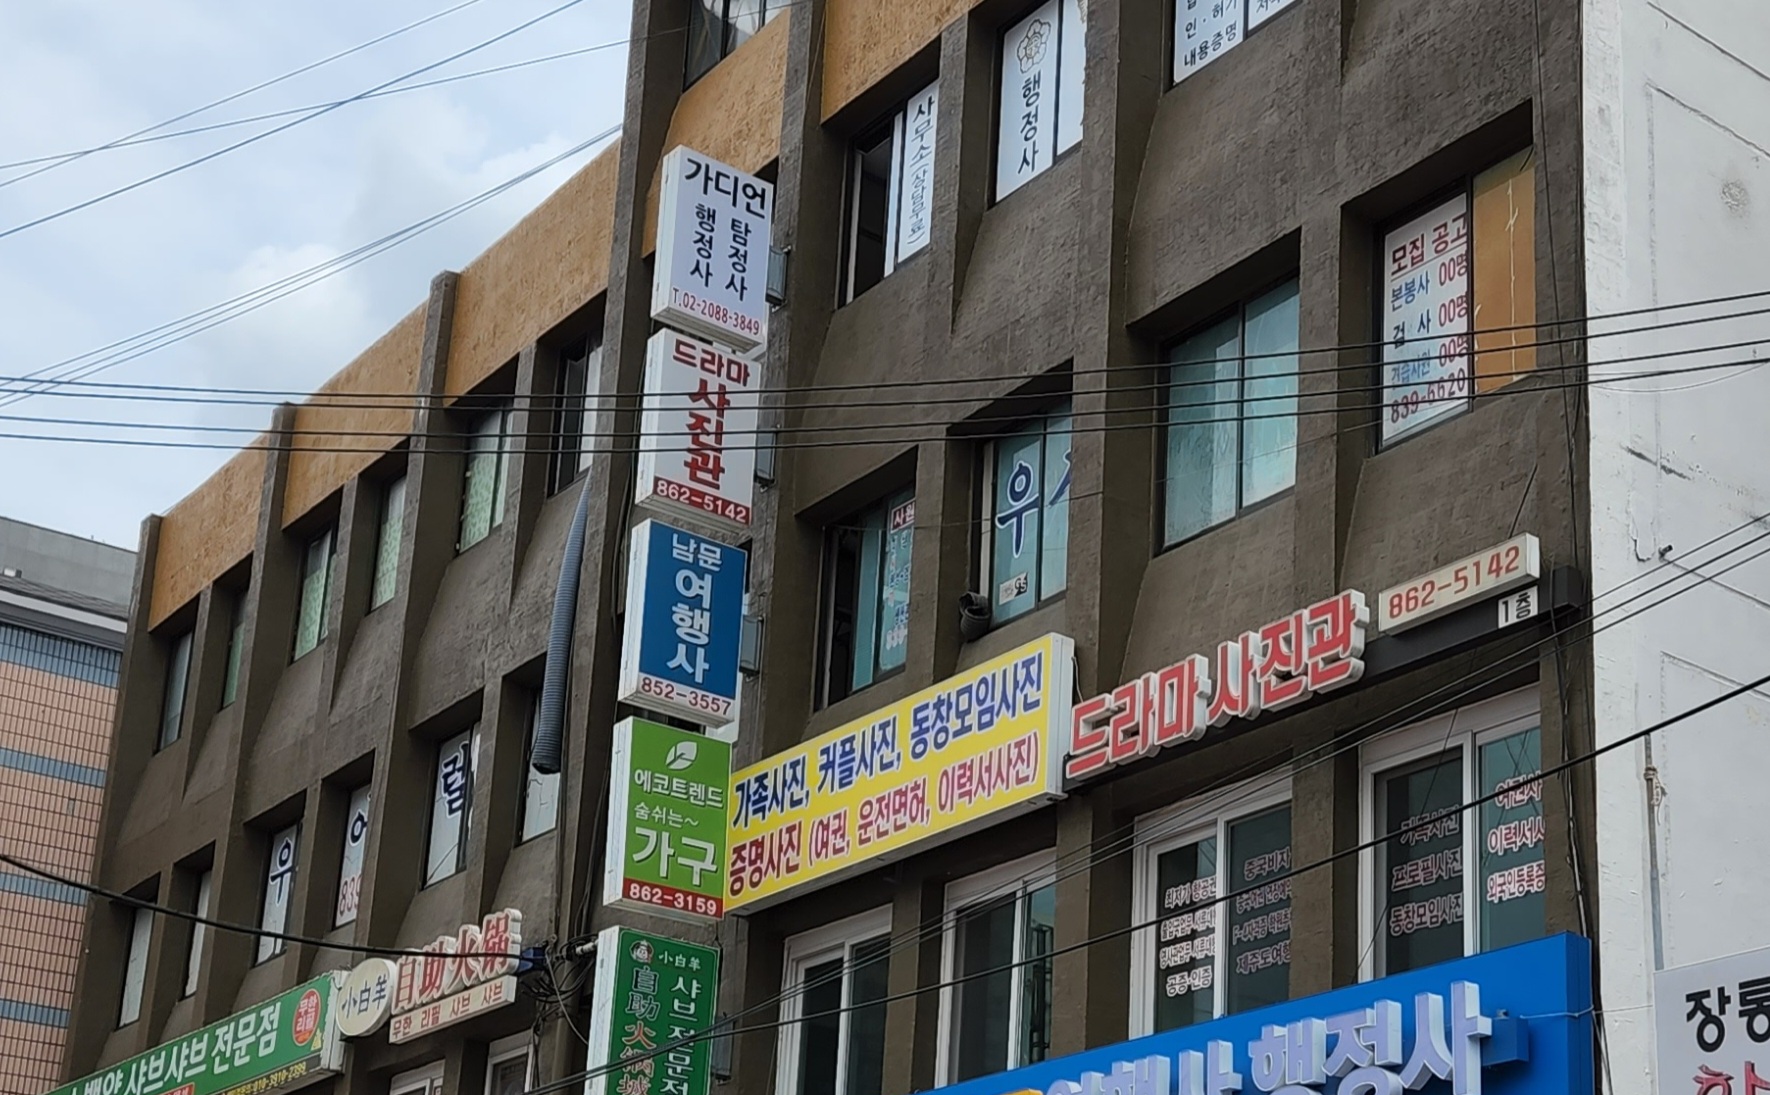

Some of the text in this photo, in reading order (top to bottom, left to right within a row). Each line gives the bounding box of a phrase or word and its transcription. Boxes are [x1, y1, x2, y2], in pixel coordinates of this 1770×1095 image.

[1184, 21, 1238, 67] 내용증명
[1017, 70, 1042, 175] 행정사
[684, 157, 767, 220] 가디언
[689, 203, 717, 288] 행정사
[724, 217, 752, 302] 탐정사
[1391, 213, 1467, 276] 모집 공고
[1391, 271, 1430, 312] 본봉사
[672, 338, 751, 388] 드라마
[683, 378, 731, 491] 사진관
[656, 480, 747, 524] 862-5142
[671, 533, 723, 573] 남문
[1388, 545, 1521, 620] 862-5142
[666, 568, 713, 685] 여행사
[1501, 592, 1534, 625] 1층
[641, 677, 732, 716] 852-3557
[909, 652, 1044, 760] 동창모임사진
[1065, 588, 1369, 780] 드라마 사진관
[633, 769, 724, 809] 에코트렌드
[632, 826, 719, 887] 가구
[729, 821, 803, 897] 증명사진
[1243, 847, 1292, 881] 중국비자
[1391, 847, 1463, 892] 프로필사진
[629, 883, 718, 916] 862-3159
[1390, 892, 1464, 937] 동창모임사진
[658, 950, 702, 972] 小白羊
[341, 974, 388, 1020] 小白羊
[210, 1001, 282, 1077] 전문점
[392, 1015, 413, 1039] 무한
[420, 1004, 441, 1029] 리필
